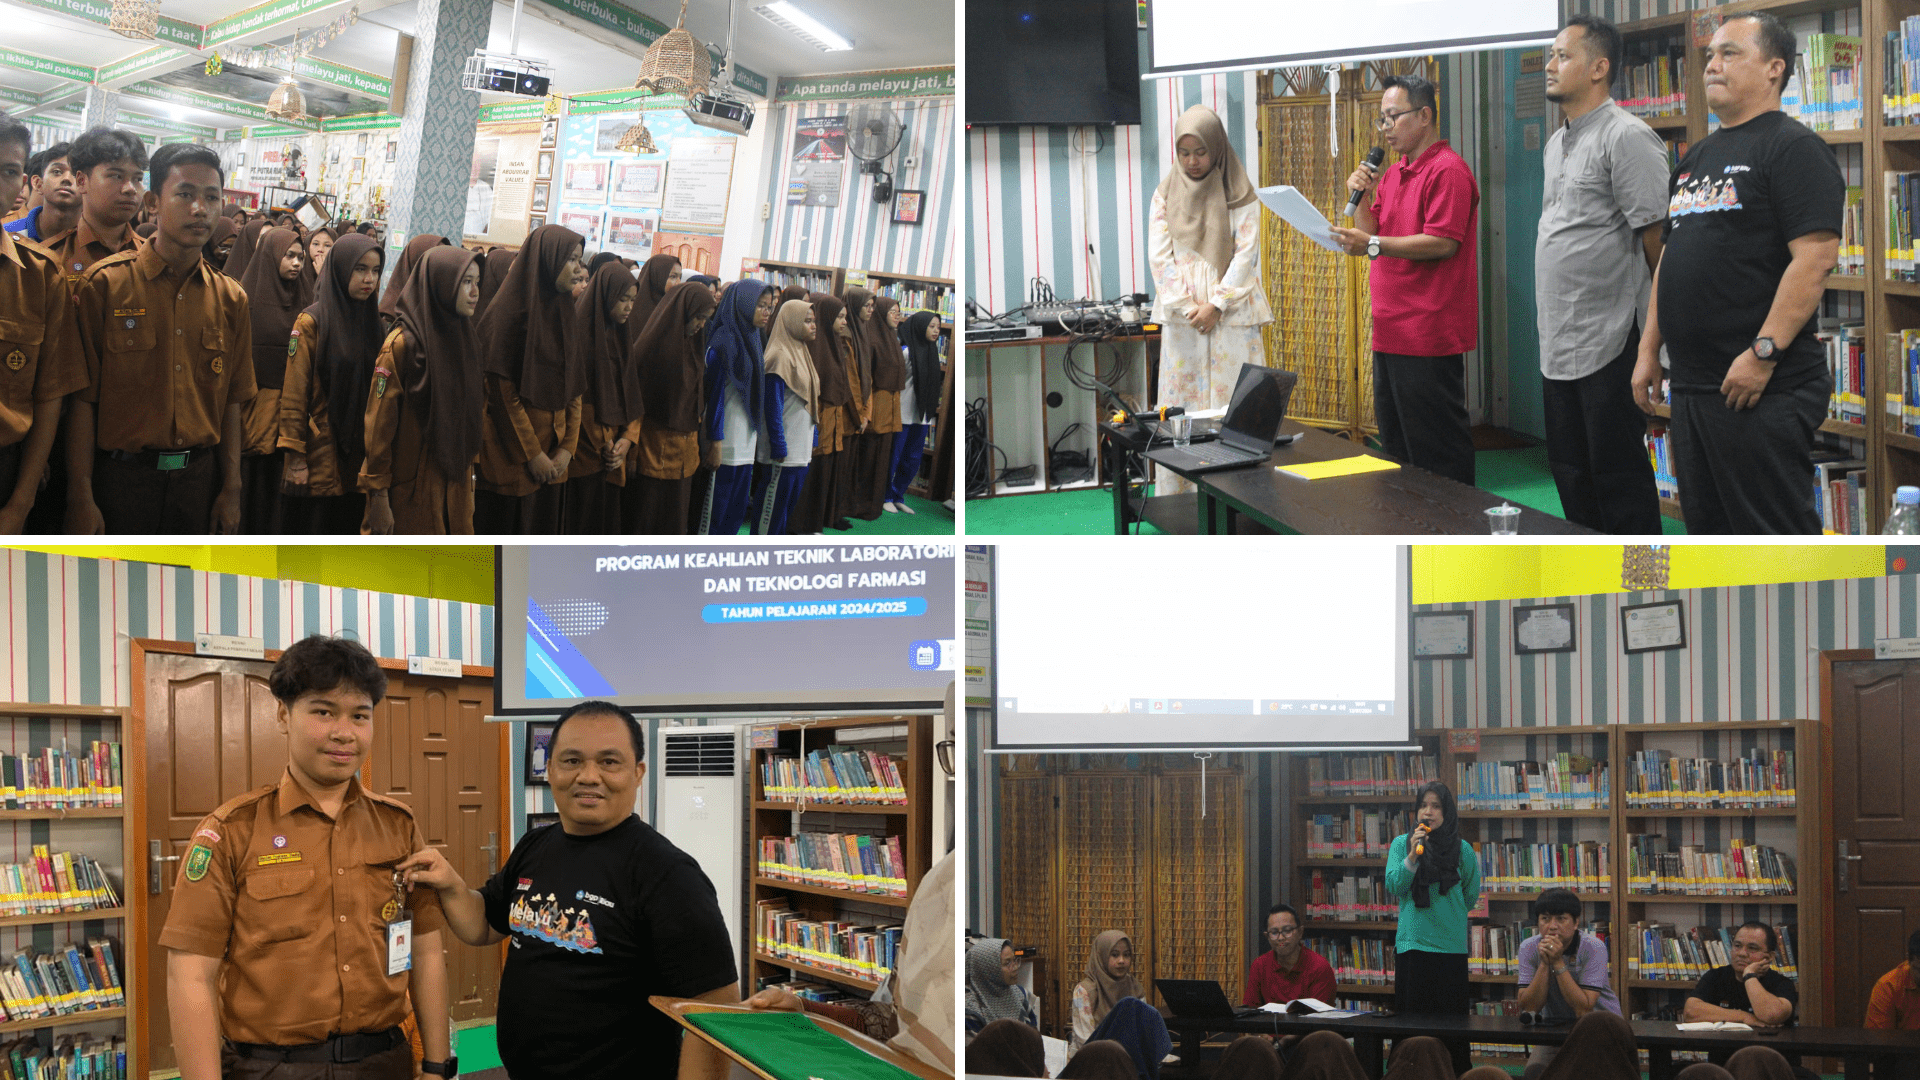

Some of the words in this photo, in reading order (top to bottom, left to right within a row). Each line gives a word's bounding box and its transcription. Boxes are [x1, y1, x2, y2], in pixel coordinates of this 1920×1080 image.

[241, 13, 264, 33] hendak
[264, 1, 300, 25] terhormat,
[171, 28, 198, 42] taat.
[6, 54, 34, 67] ikhlas
[35, 58, 53, 71] jadi
[54, 64, 92, 79] pakaian.
[1522, 56, 1543, 67] TOILET
[301, 63, 335, 79] melayu
[335, 70, 353, 85] jati,
[354, 77, 387, 94] kepada
[736, 71, 764, 92] ditahan.
[793, 84, 816, 97] Apa
[819, 81, 856, 94] tanda
[859, 78, 910, 93] melayu
[912, 76, 942, 92] jati,
[945, 75, 956, 87] b
[595, 555, 680, 572] PROGRAM
[684, 551, 770, 569] KEAHLIAN
[774, 549, 835, 566] TEKNIK
[841, 545, 956, 562] LABORATORI
[704, 577, 742, 594] DAN
[746, 574, 844, 592] TEKNOLOGI
[848, 570, 927, 589] FARMASI
[721, 606, 764, 619] TAHUN
[766, 604, 837, 618] PELAJARAN
[840, 601, 908, 616] 2024/2025
[584, 891, 599, 902] bgp
[510, 902, 552, 927] Melayu
